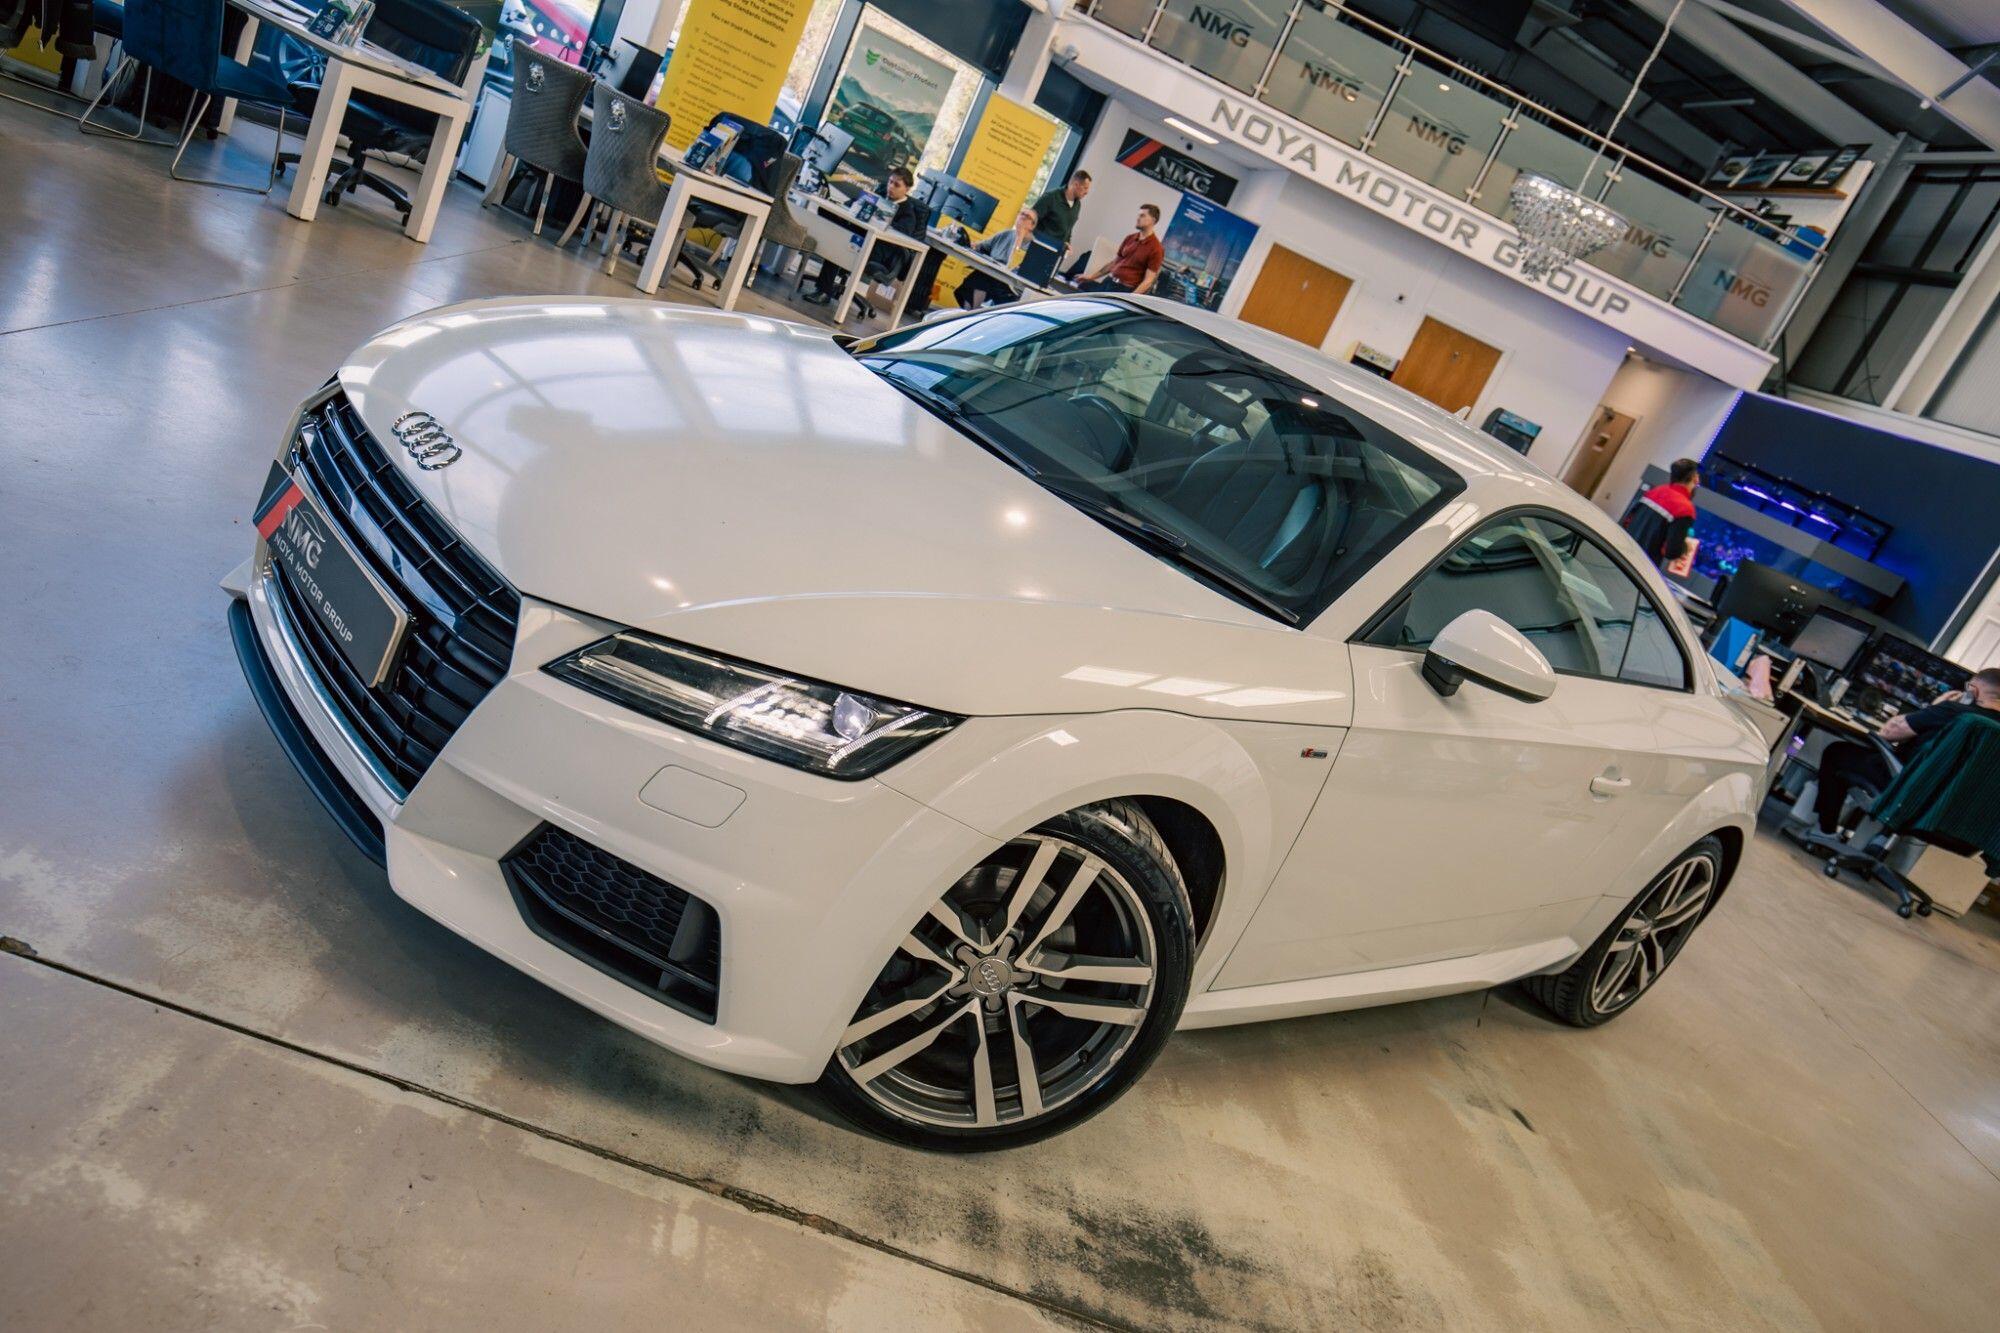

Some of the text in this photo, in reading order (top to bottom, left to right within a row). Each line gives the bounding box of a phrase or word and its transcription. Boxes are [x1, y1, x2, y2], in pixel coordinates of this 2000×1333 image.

[732, 1, 762, 20] Standards
[1189, 6, 1251, 48] NMG
[880, 56, 939, 90] Customer Protect
[1300, 61, 1361, 102] NMG
[1406, 115, 1467, 156] NMG
[1155, 156, 1211, 194] NMG
[1211, 99, 1630, 314] NOYA MOTOR GOUP
[1713, 269, 1771, 309] NMG
[281, 504, 323, 569] NMG
[274, 532, 353, 643] NOYA MOTOR GROUP
